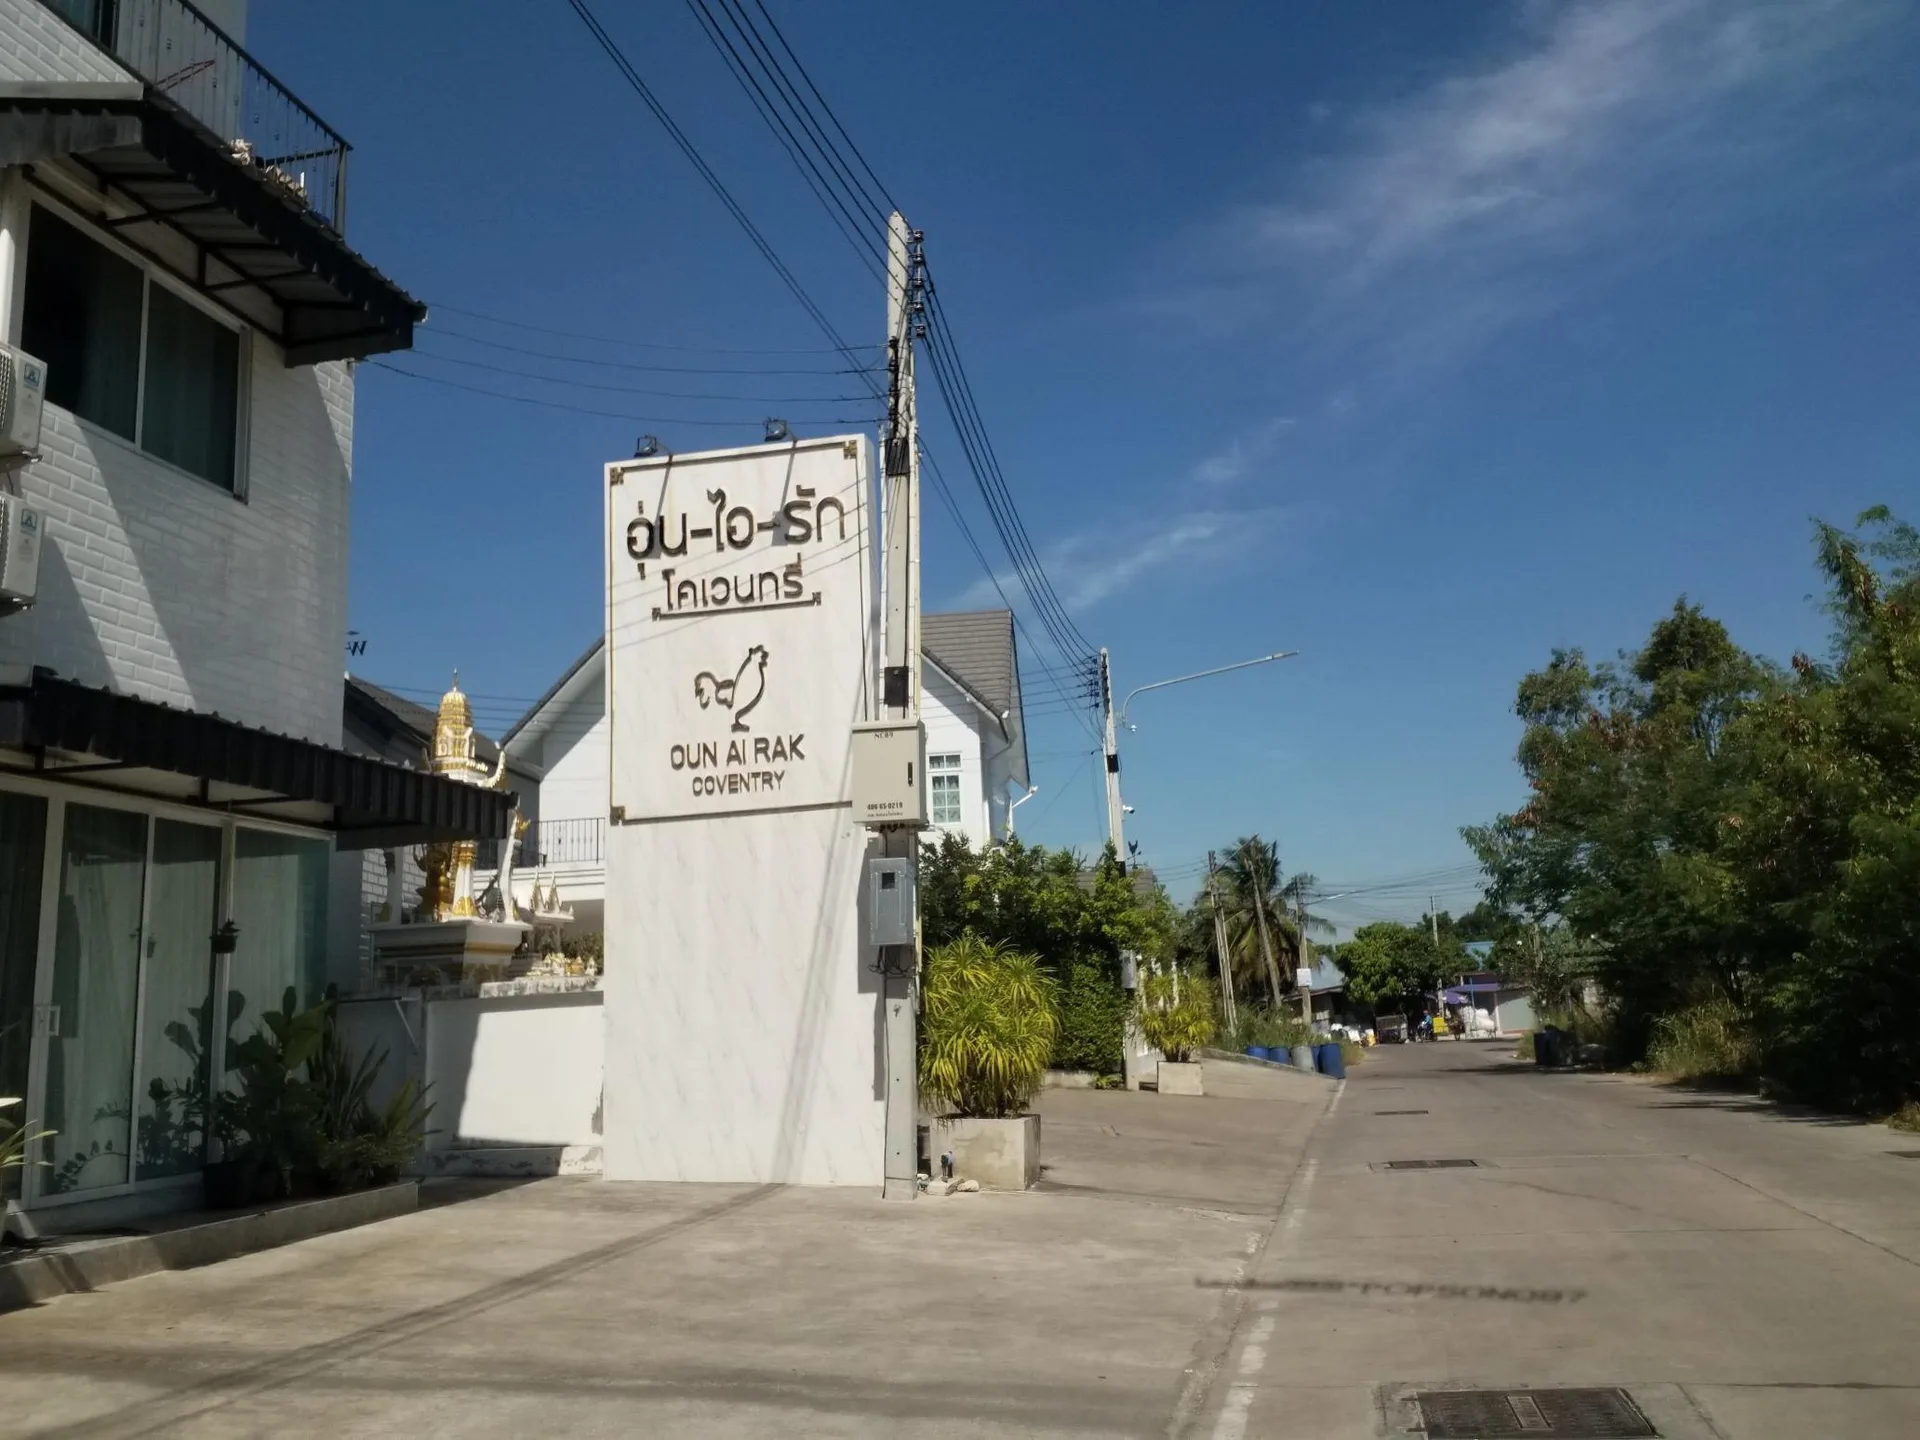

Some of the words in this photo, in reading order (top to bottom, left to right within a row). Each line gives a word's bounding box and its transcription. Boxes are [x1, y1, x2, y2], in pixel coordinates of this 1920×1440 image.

[626, 484, 846, 581] อุ่น-ไอ-รัก
[661, 552, 804, 612] โคเวนทรี
[670, 741, 718, 771] OUN
[726, 739, 747, 767] AI
[754, 733, 805, 764] RAK
[692, 770, 786, 797] COVENTRY
